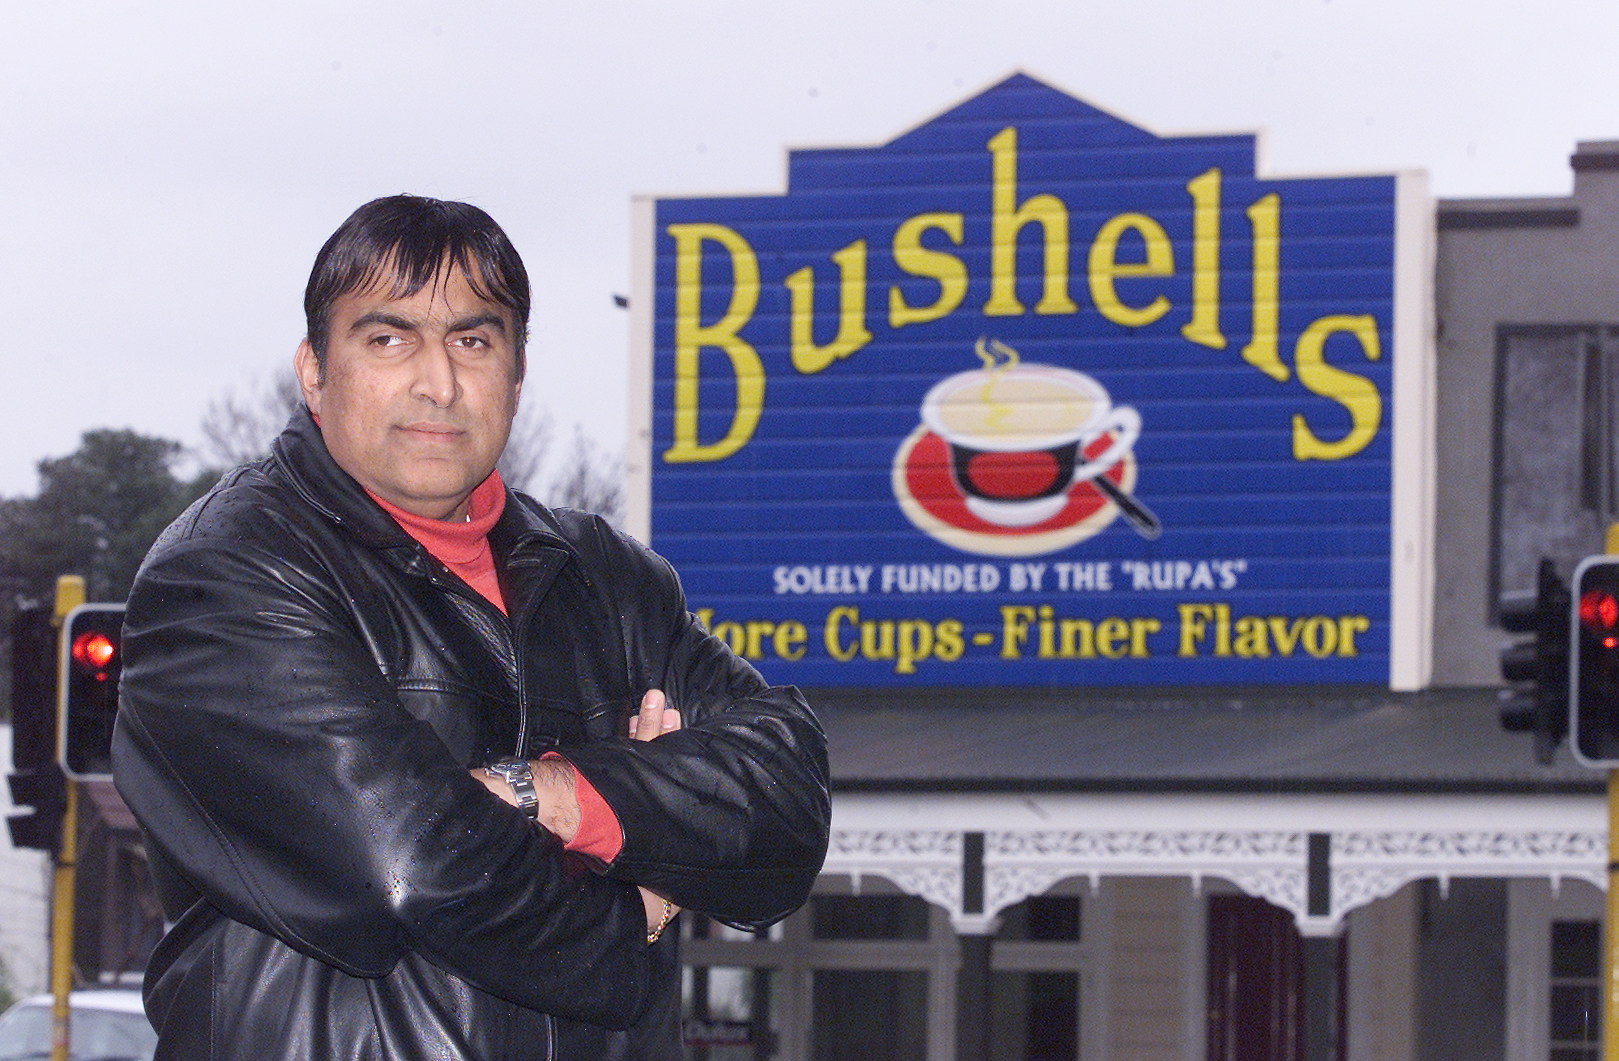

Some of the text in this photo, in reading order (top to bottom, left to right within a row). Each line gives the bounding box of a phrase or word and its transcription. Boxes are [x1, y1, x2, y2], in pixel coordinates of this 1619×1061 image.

[662, 126, 1383, 464] Bushells
[773, 565, 873, 594] SOLELY
[881, 563, 1001, 593] FUNDED
[1008, 563, 1046, 592] BY
[1053, 562, 1112, 591] THE
[696, 606, 808, 661] ore
[823, 606, 965, 674] Cups
[1000, 604, 1162, 660] Finer
[1176, 603, 1370, 659] Flavor
